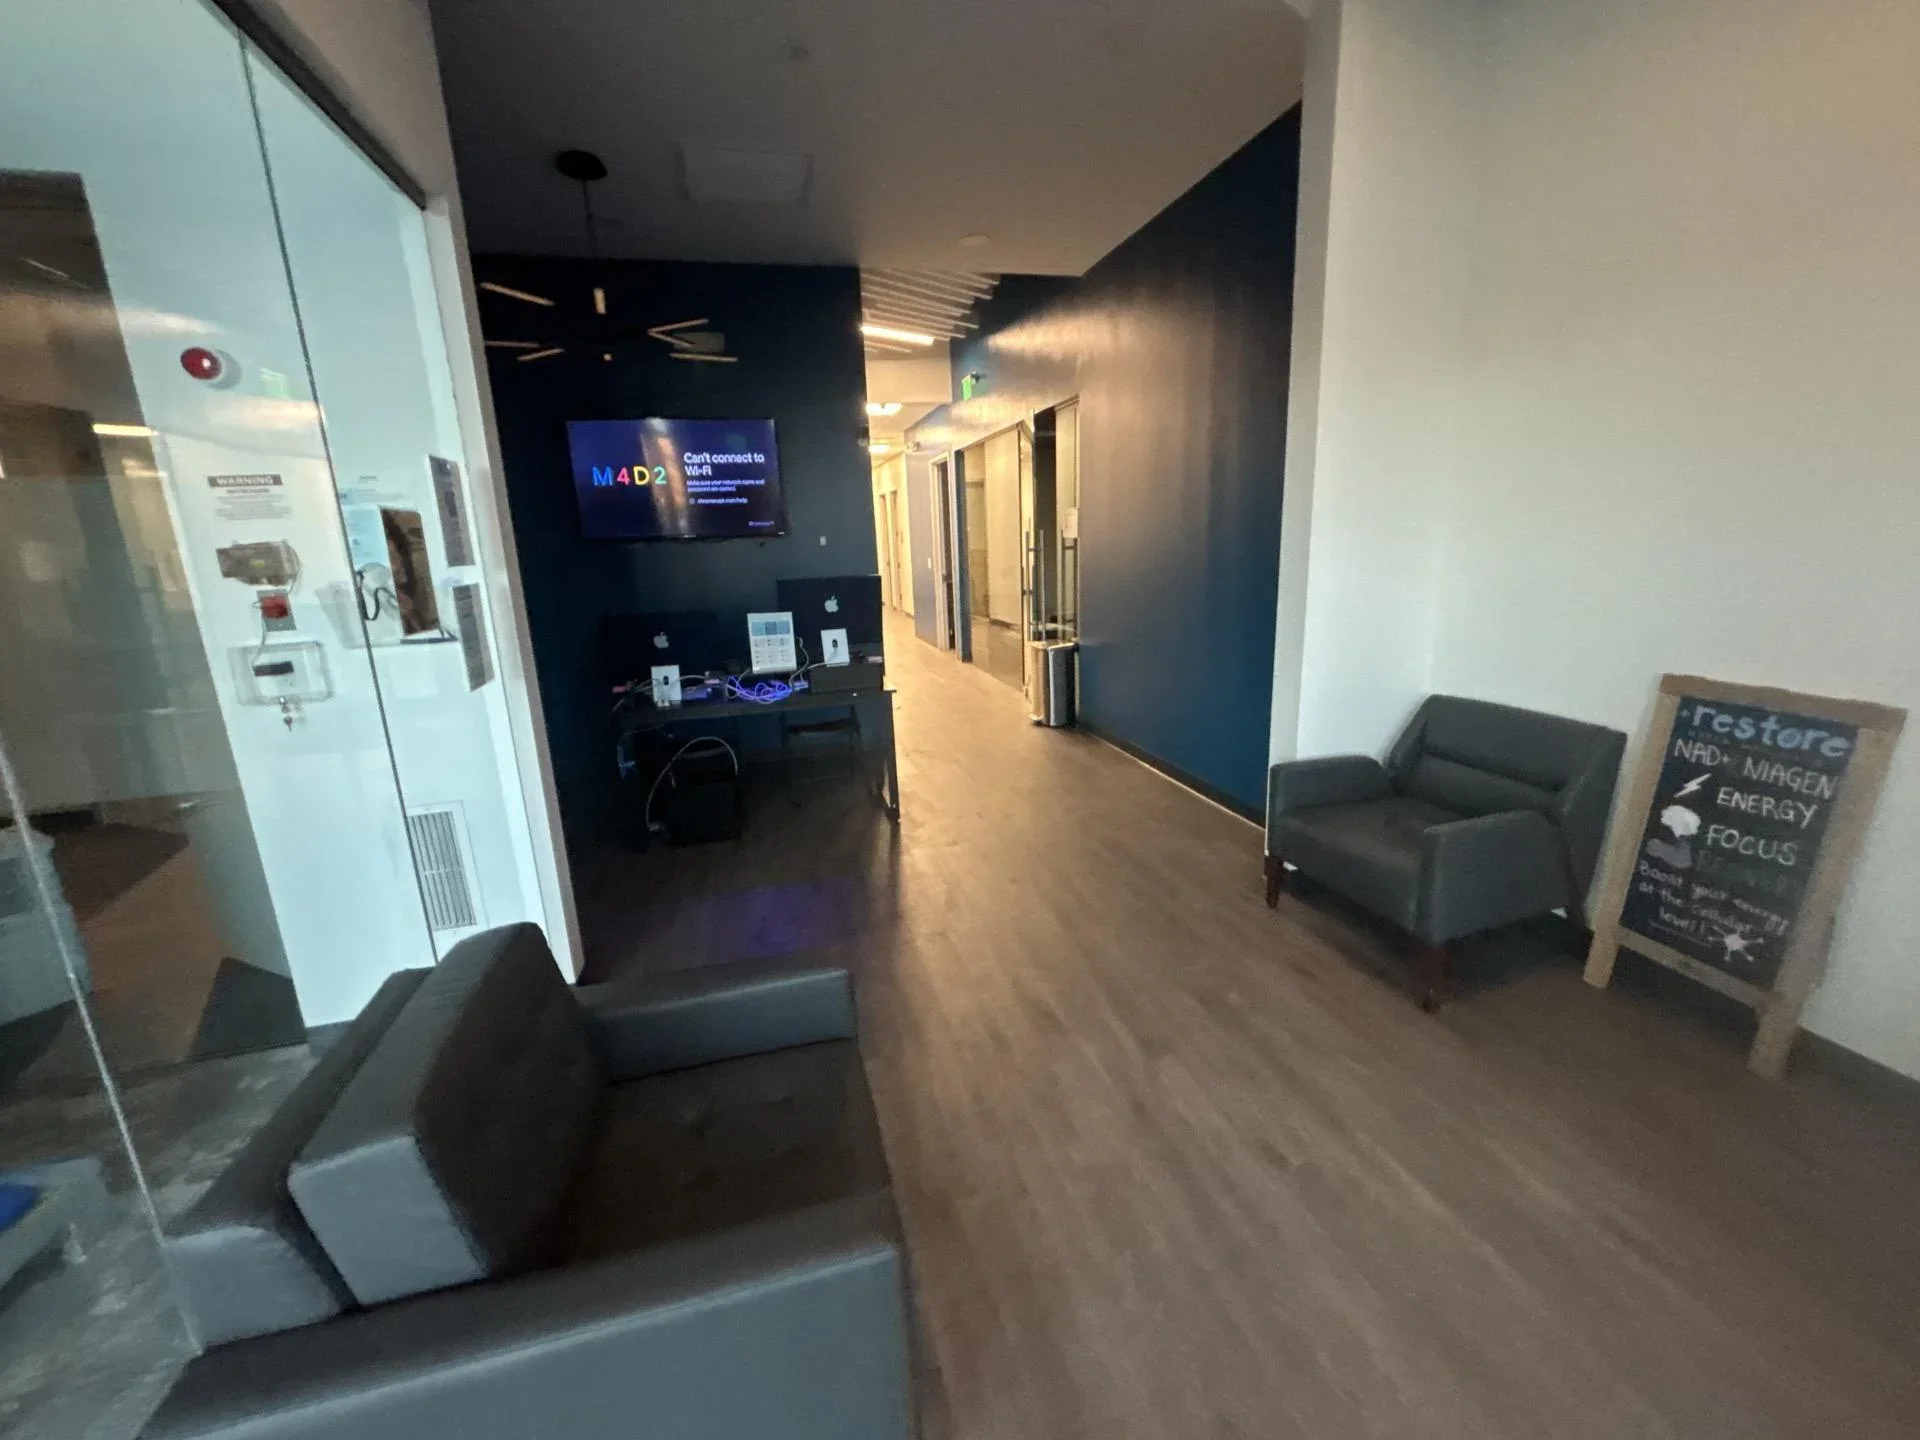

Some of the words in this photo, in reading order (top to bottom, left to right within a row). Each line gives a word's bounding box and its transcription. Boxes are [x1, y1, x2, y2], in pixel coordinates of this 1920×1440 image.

[683, 452, 711, 463] Can't
[712, 452, 752, 463] connect
[753, 452, 765, 463] to
[684, 464, 713, 476] Wi-Fi
[216, 476, 274, 486] WARNING
[1692, 705, 1849, 757] restore
[1673, 738, 1730, 766] NAD+
[1716, 786, 1818, 829] ENERGY
[1706, 824, 1799, 866] FOCUS
